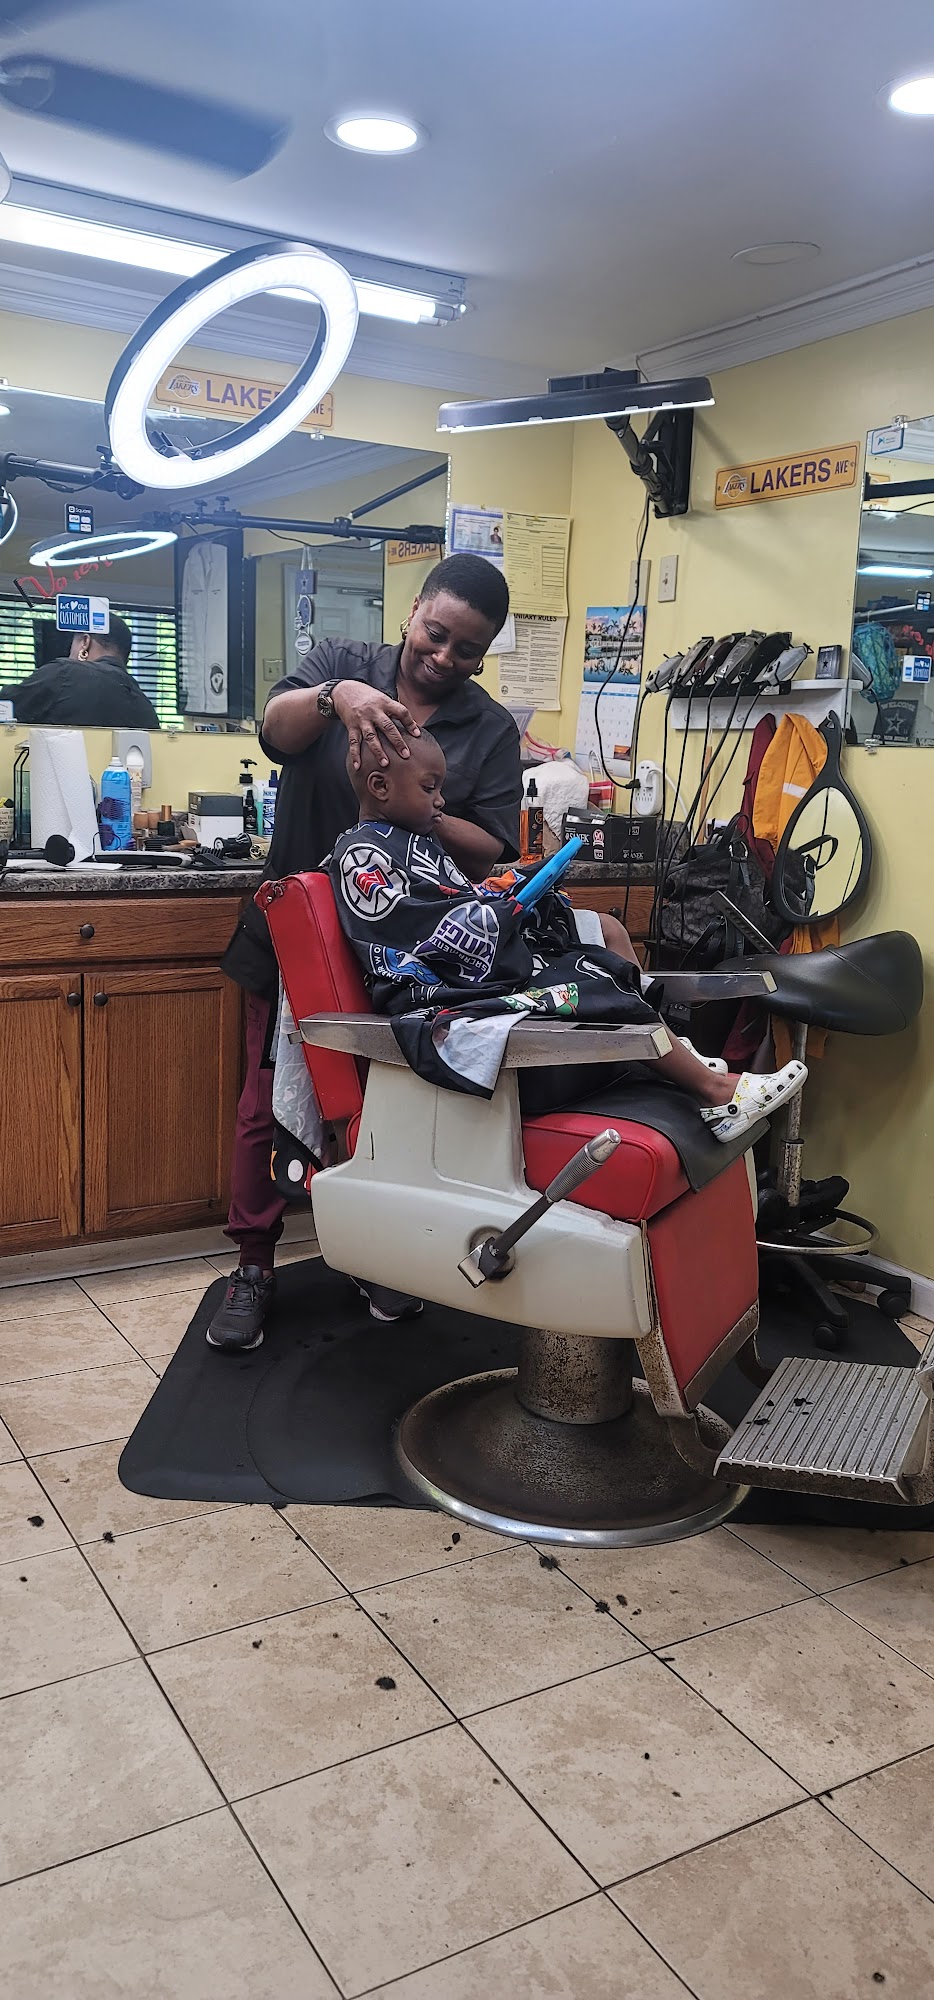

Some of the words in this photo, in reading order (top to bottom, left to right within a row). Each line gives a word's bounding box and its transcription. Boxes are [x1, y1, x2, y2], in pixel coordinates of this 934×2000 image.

[206, 380, 280, 410] LAKE
[750, 458, 831, 494] LAKERS
[834, 460, 848, 475] AVE
[60, 611, 88, 625] CUSTOMERS
